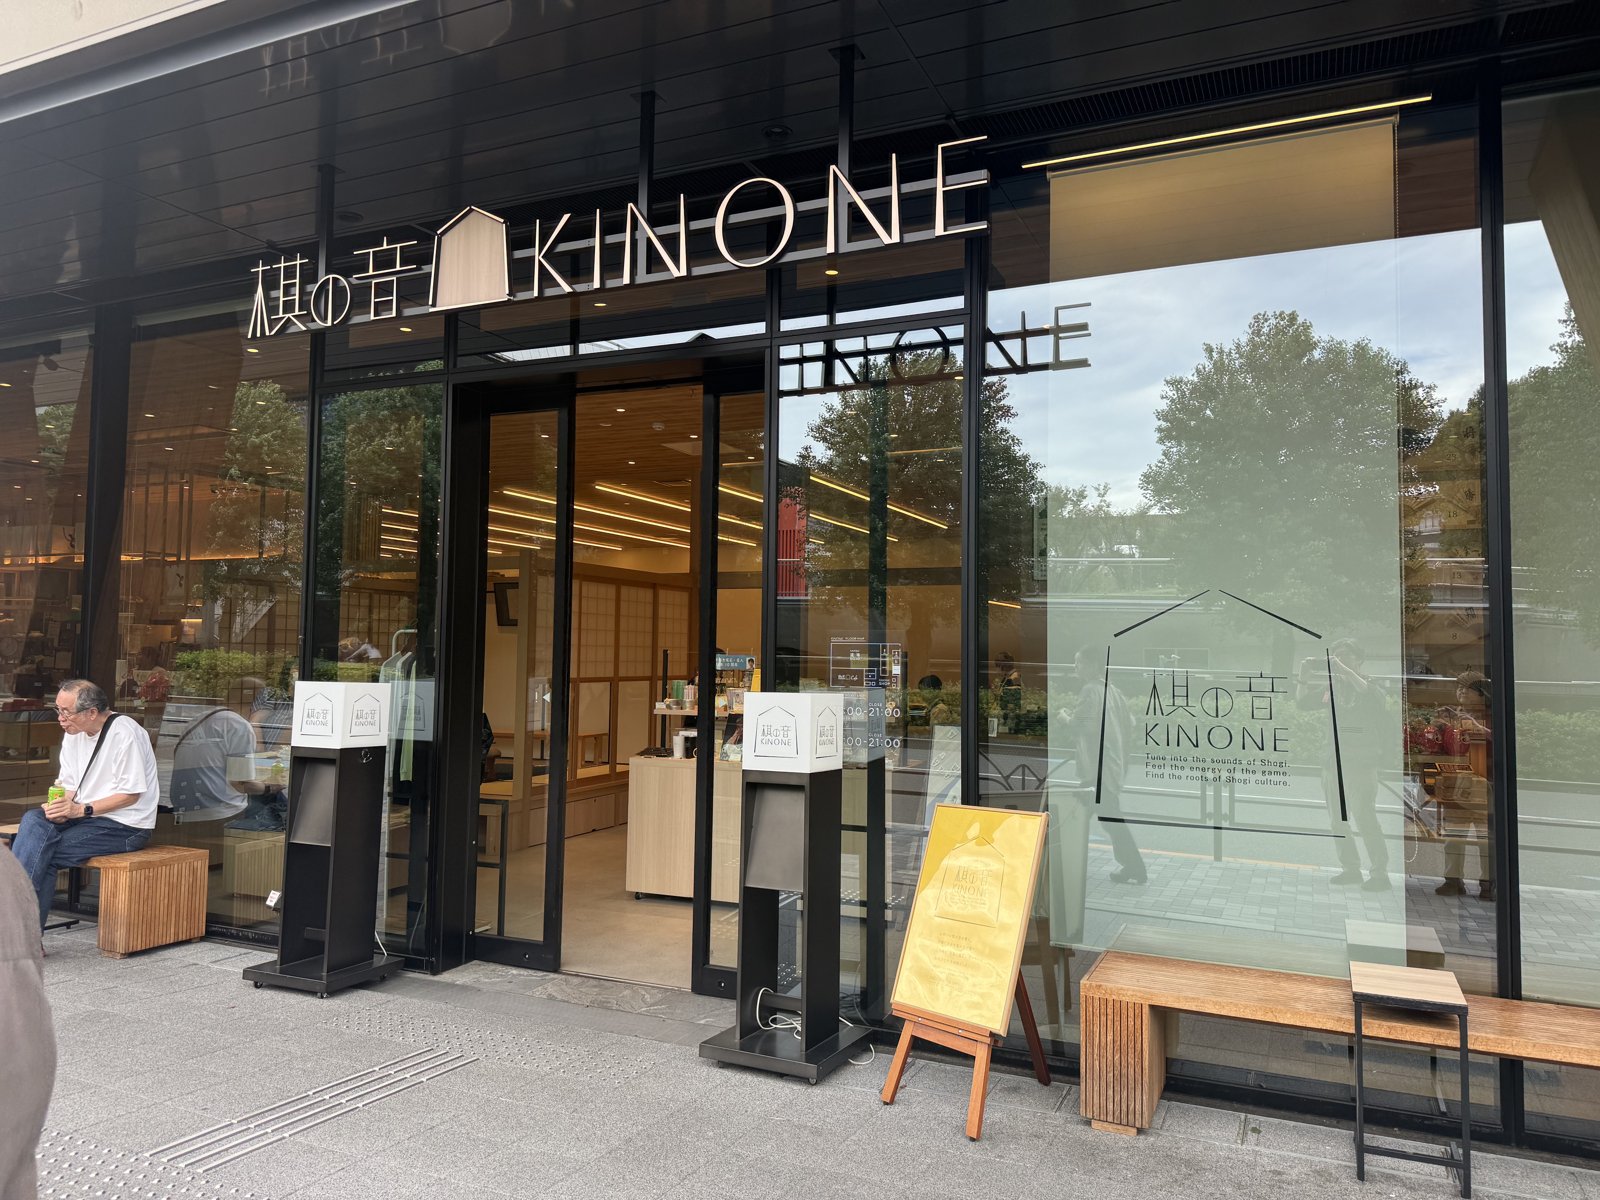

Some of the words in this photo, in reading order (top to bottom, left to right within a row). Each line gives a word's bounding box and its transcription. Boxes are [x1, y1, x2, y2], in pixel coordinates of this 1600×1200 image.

[534, 136, 989, 297] KINONE
[247, 235, 417, 338] 棋の音
[1451, 571, 1462, 579] 13
[1145, 669, 1288, 721] 棋の音
[760, 738, 792, 747] KINONE
[1145, 723, 1289, 753] KINONE
[1145, 752, 1167, 761] Tune
[1170, 755, 1188, 763] into
[1192, 755, 1206, 764] the
[1210, 756, 1243, 766] sounds
[1246, 758, 1256, 766] of
[1260, 759, 1291, 769] Shogi.
[1145, 762, 1166, 770] Feel
[1170, 763, 1185, 772] the
[1189, 765, 1223, 774] energy
[1226, 766, 1237, 774] of
[1241, 767, 1257, 776] the
[1261, 769, 1291, 777] game.
[1145, 771, 1165, 779] Find
[1168, 772, 1182, 780] the
[1185, 774, 1209, 782] roots
[1212, 775, 1222, 783] of
[1225, 776, 1251, 785] Shogi
[1254, 777, 1291, 787] culture.
